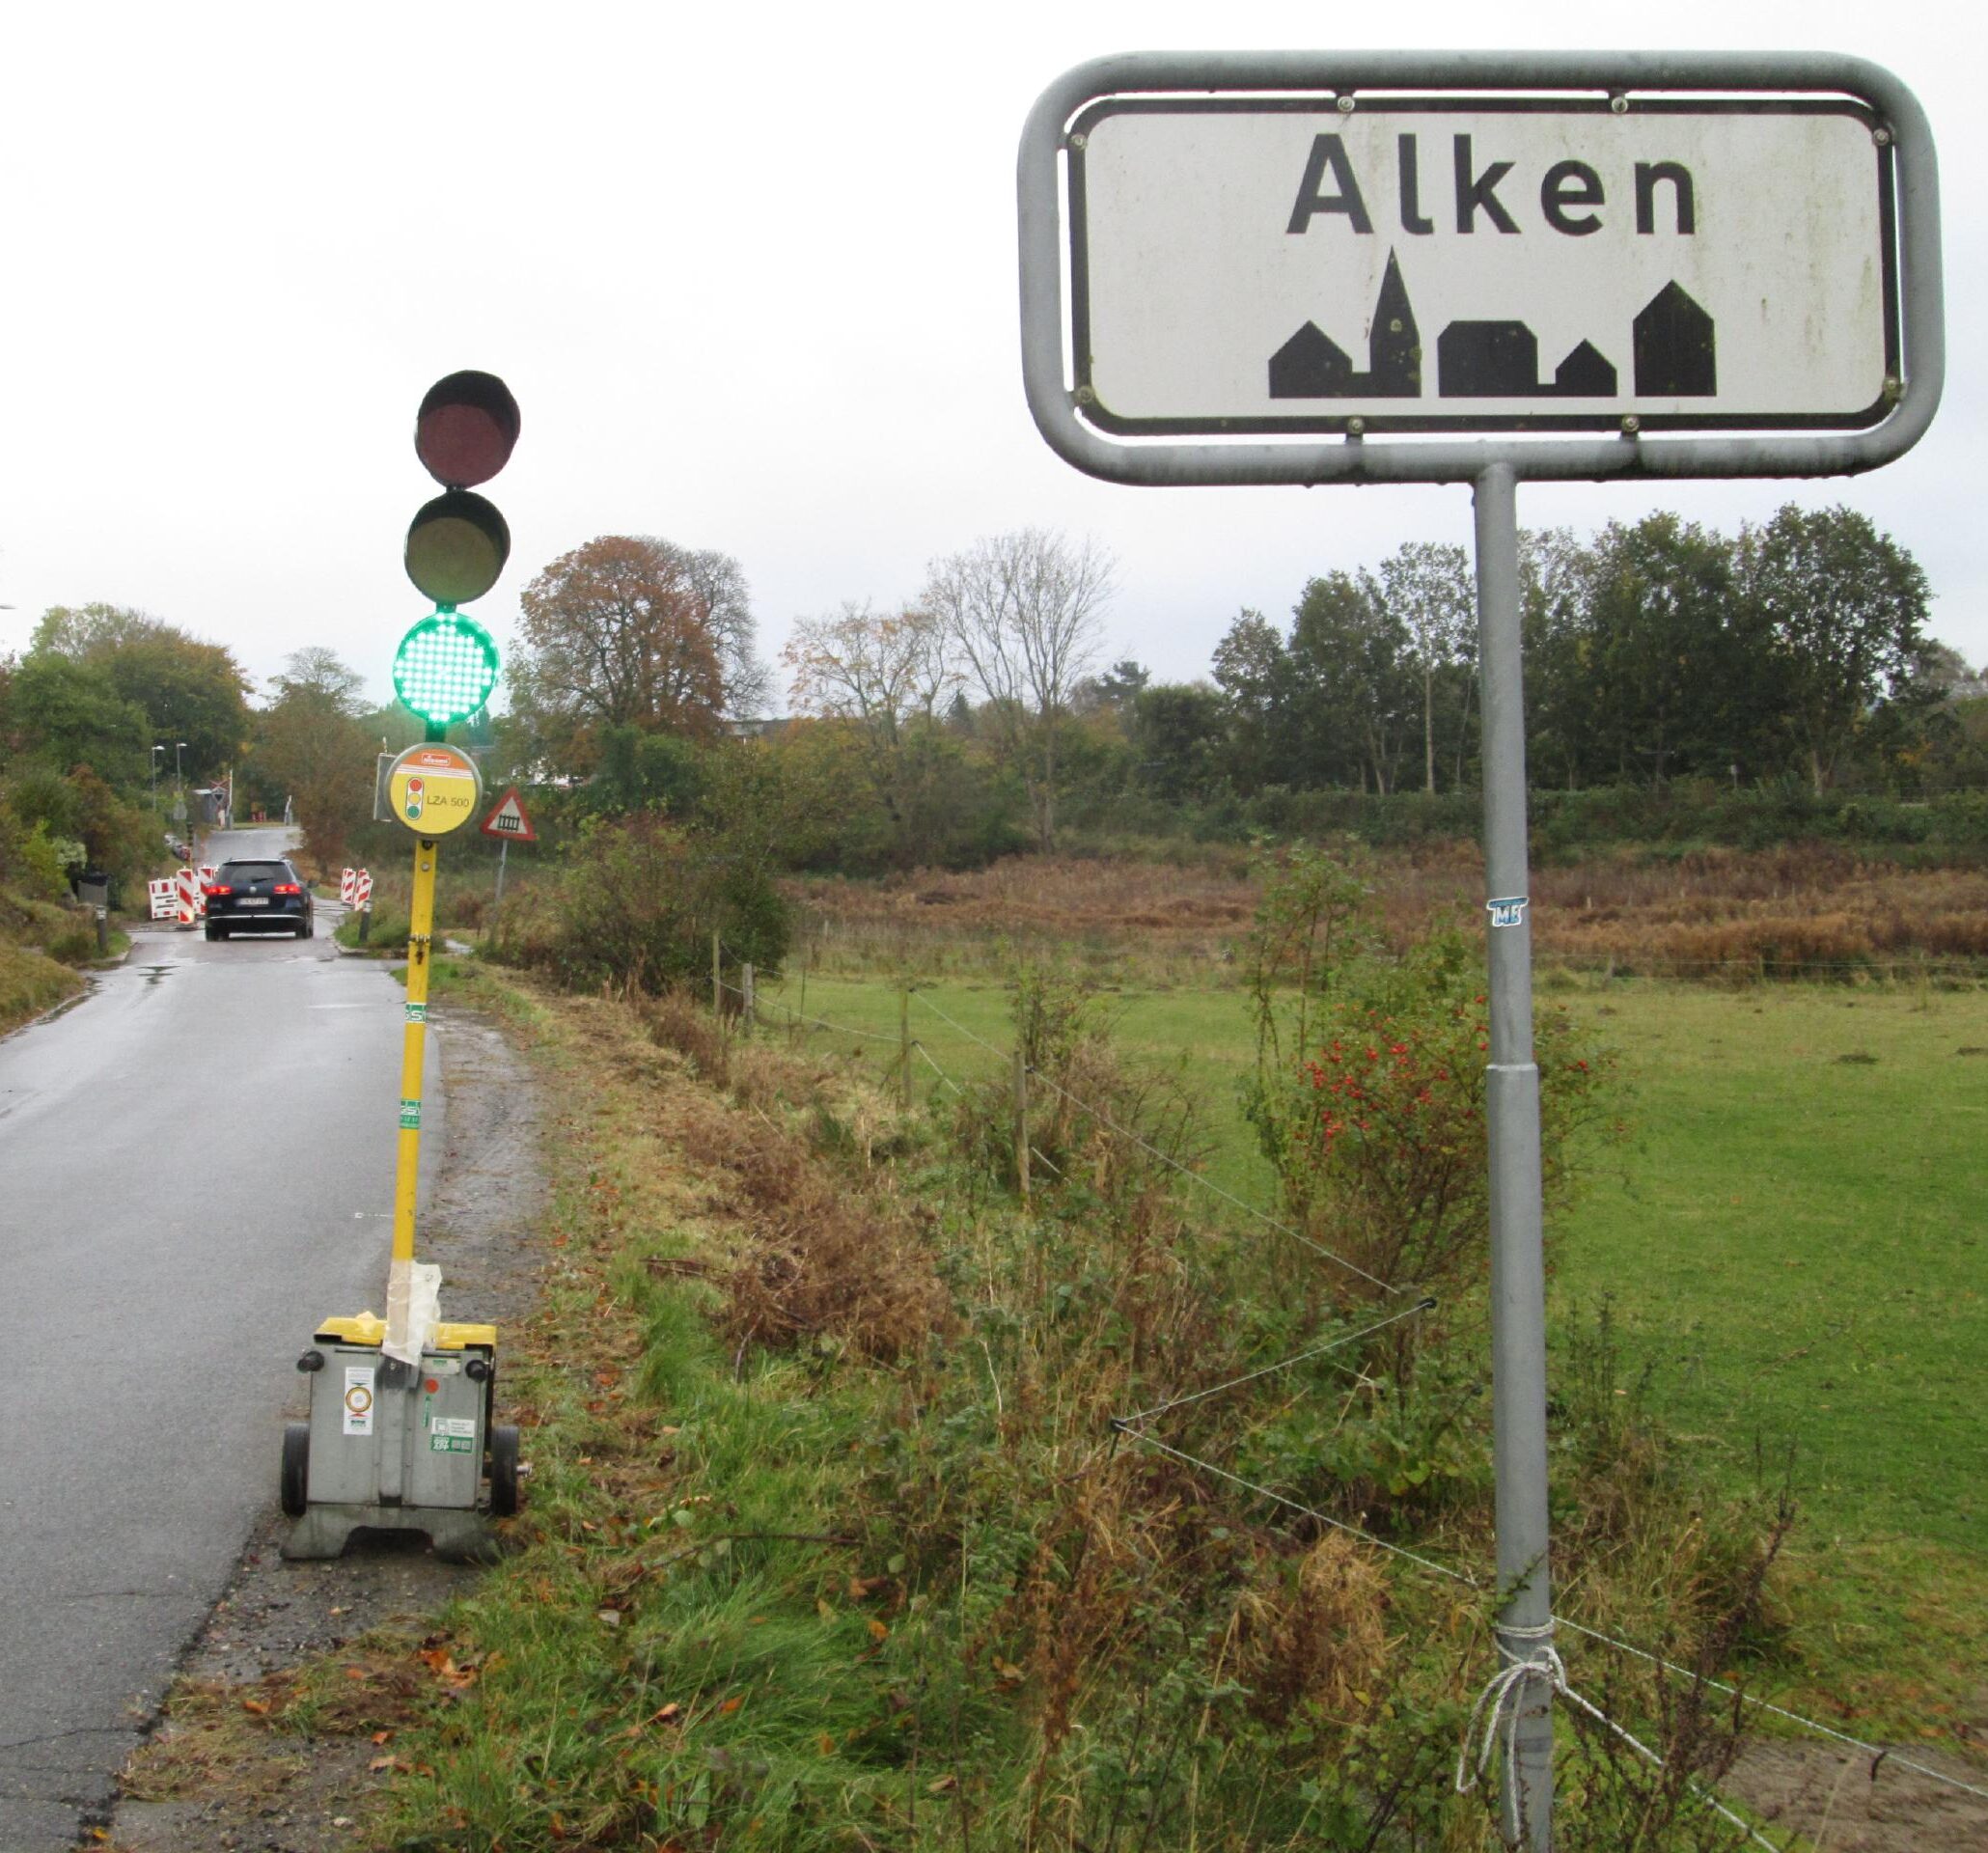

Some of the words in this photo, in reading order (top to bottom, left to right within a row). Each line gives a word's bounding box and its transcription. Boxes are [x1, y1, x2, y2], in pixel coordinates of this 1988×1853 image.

[1285, 132, 1696, 236] Alken
[427, 795, 447, 805] LZA
[451, 797, 470, 808] 500
